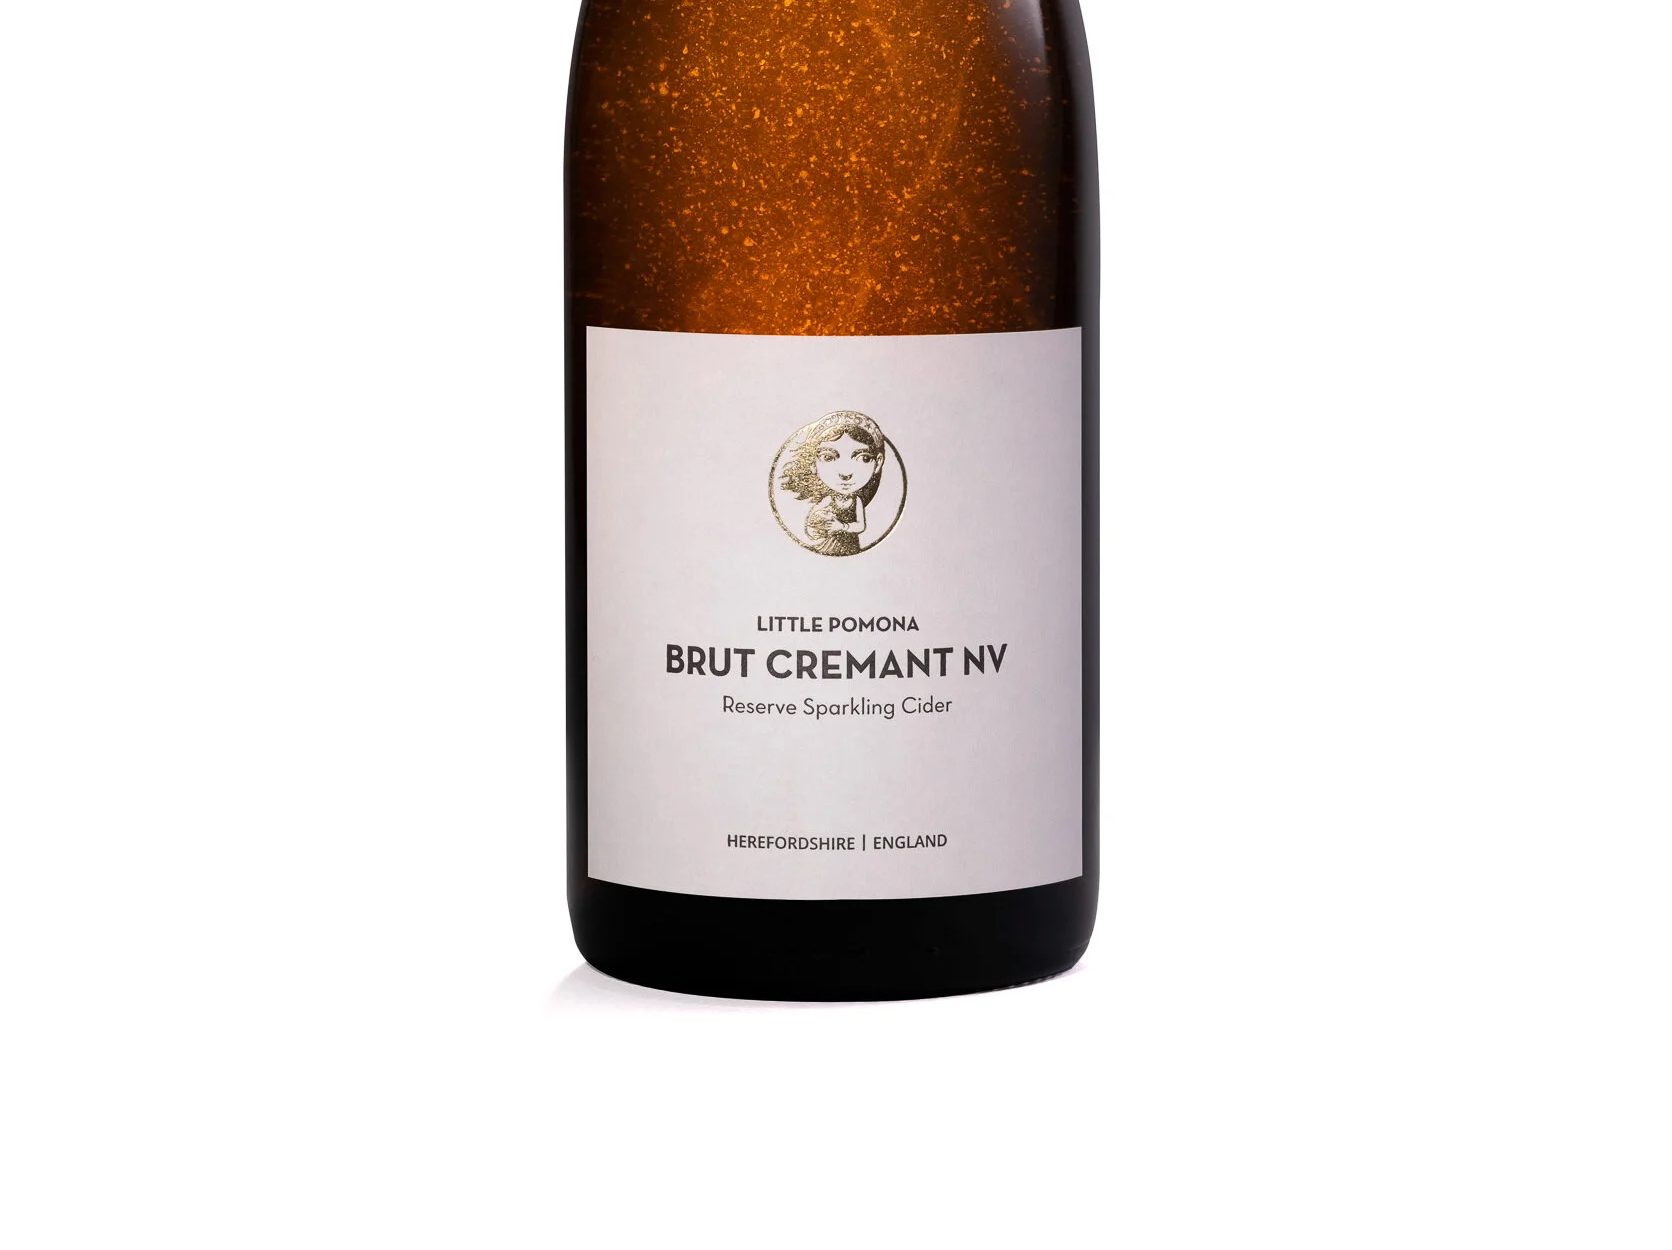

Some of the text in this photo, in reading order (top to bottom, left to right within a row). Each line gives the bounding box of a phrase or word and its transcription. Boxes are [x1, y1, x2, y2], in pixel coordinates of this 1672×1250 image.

[757, 615, 920, 632] LITTLE POMONA
[666, 643, 1008, 680] BRUT CREMANT NV
[722, 695, 953, 720] Reserve Sparkling Cider
[727, 833, 948, 851] HEREFORDSHIRE ENGLAND
